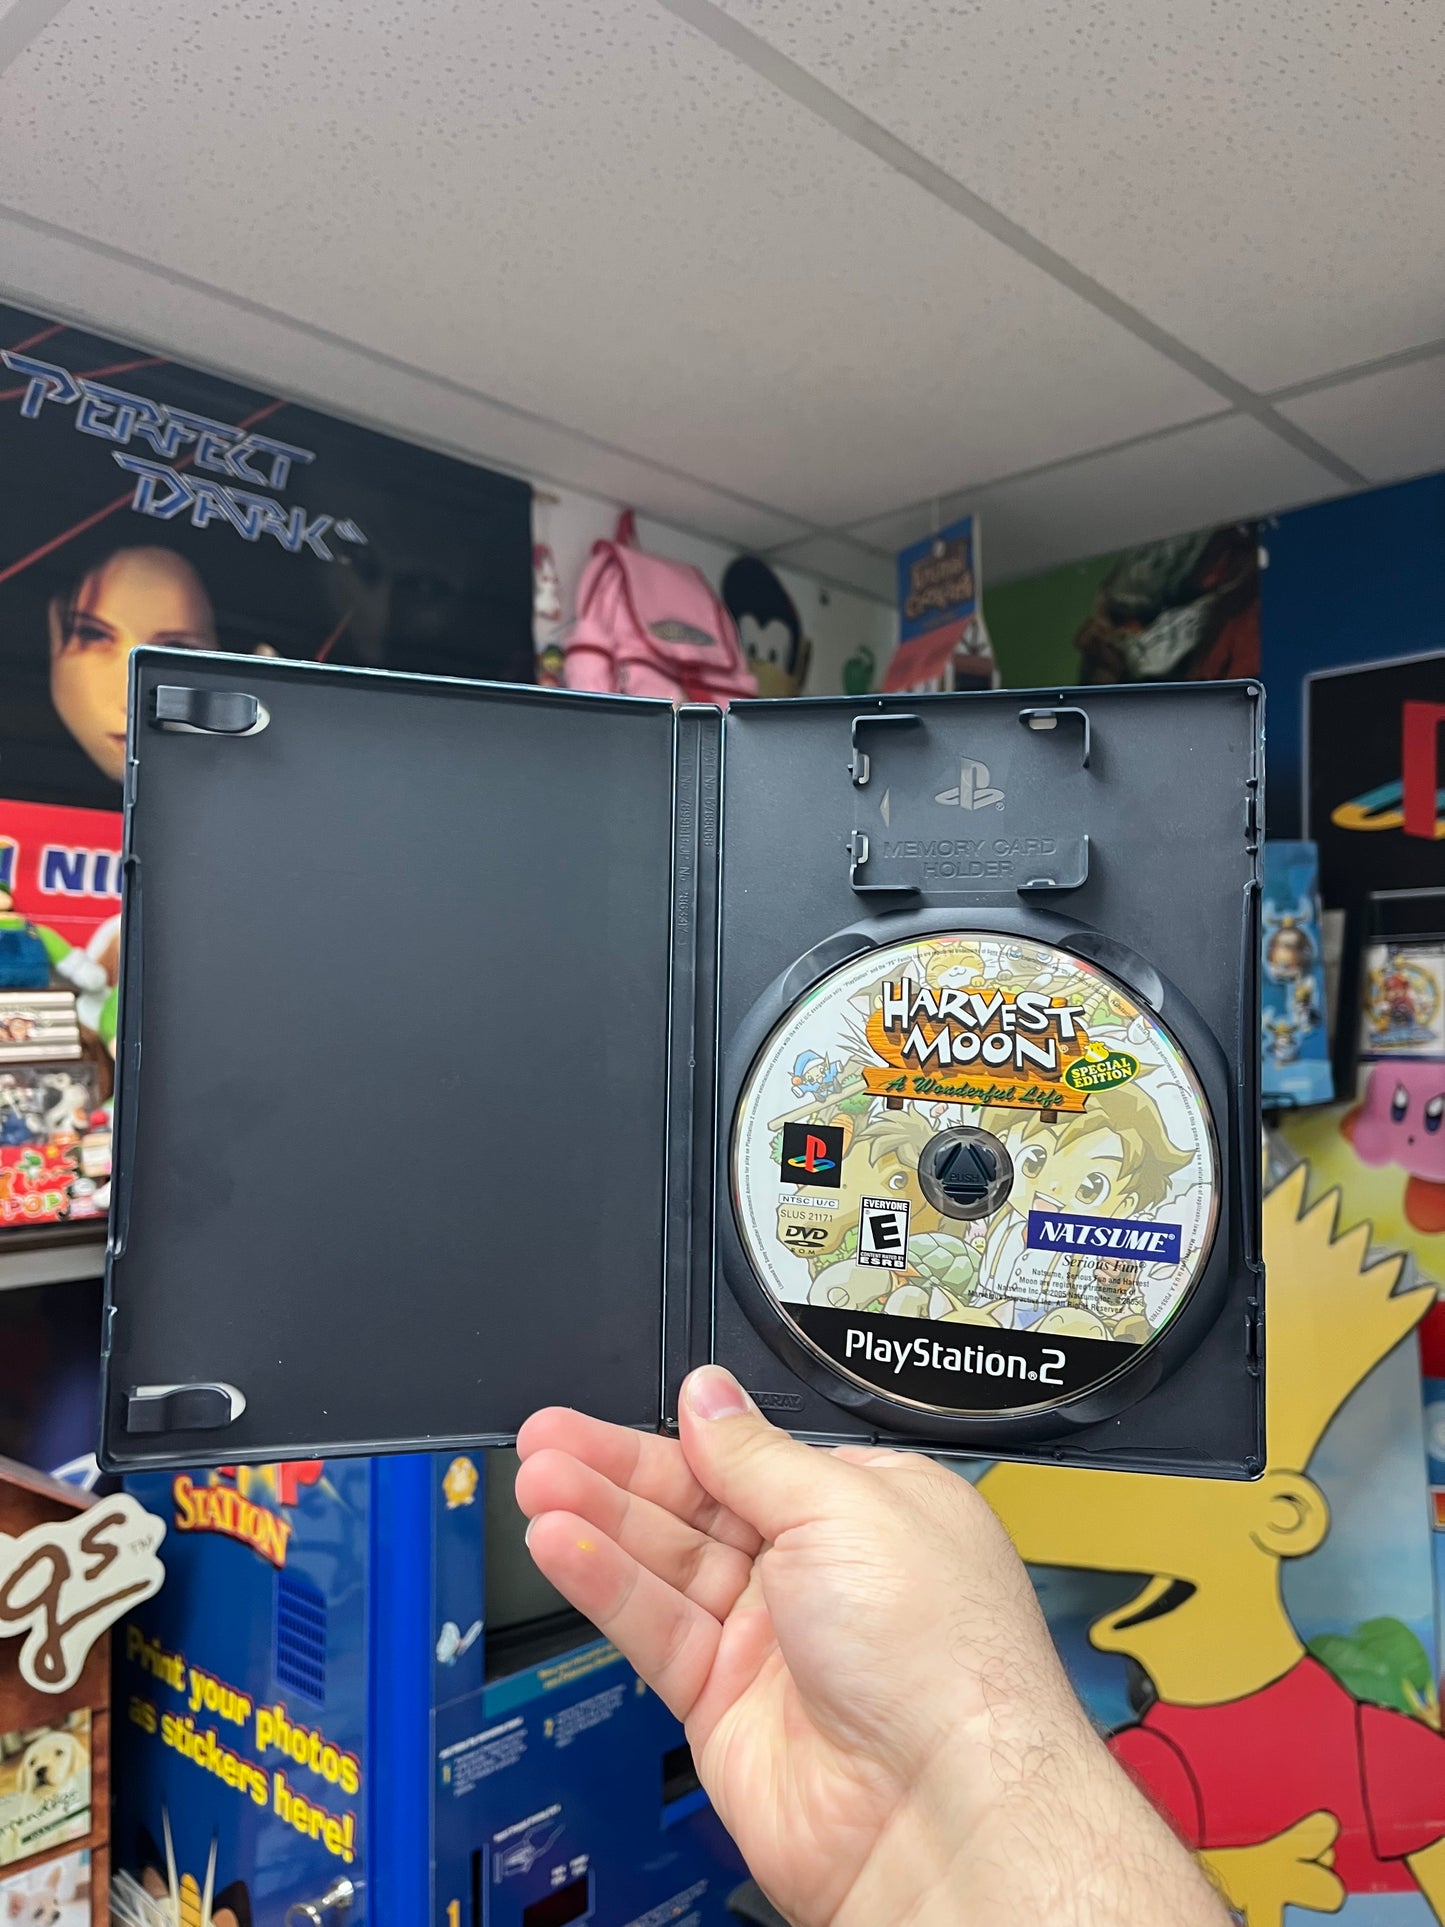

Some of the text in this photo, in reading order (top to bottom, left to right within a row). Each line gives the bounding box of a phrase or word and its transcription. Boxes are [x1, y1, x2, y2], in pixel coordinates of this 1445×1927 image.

[0, 350, 316, 490] PERFECT
[112, 451, 335, 562] DARK
[883, 838, 1057, 859] MEMORY CARD
[44, 849, 120, 893] NI
[923, 861, 1017, 879] HOLDER
[868, 965, 878, 974] and
[877, 962, 886, 970] the
[808, 992, 834, 1015] designation
[882, 977, 1085, 1041] HARVEST
[781, 1035, 791, 1046] with
[787, 1028, 796, 1037] the
[770, 1044, 786, 1064] systems
[1070, 1058, 1130, 1080] SPECIAL
[1156, 1049, 1178, 1080] performance
[756, 1061, 774, 1094] entertainment
[1073, 1067, 1133, 1089] EDITION
[885, 1075, 1065, 1107] A Wonderful Life
[749, 1092, 762, 1116] computer
[1188, 1115, 1196, 1126] this
[744, 1119, 755, 1147] PlayStation
[1190, 1126, 1199, 1141] game
[745, 1194, 757, 1228] Entertainment
[782, 1196, 836, 1207] NTSC U/C
[863, 1199, 908, 1212] EVERYONE
[1192, 1195, 1202, 1222] applicable
[780, 1209, 834, 1223] SLUS 21171
[752, 1227, 766, 1251] Computer
[785, 1225, 829, 1240] DVD
[869, 1213, 902, 1250] E
[760, 1250, 771, 1263] Sony
[765, 1262, 774, 1270] by
[860, 1252, 881, 1260] CONTENT
[881, 1253, 898, 1261] RATED
[860, 1258, 904, 1268] ESRB
[1062, 1254, 1109, 1271] Serious
[768, 1268, 784, 1290] Licensed
[1019, 1276, 1038, 1285] Moon
[1039, 1279, 1050, 1287] are
[1052, 1280, 1088, 1291] registered
[1089, 1284, 1127, 1295] trademarks
[1032, 1268, 1150, 1288] Natsume, Serious Fun and Harvest
[997, 1283, 1027, 1293] Natsume
[1068, 1291, 1098, 1301] Natsume
[1067, 1300, 1089, 1310] Rights
[174, 1475, 292, 1568] STATION
[126, 1625, 186, 1692] Print
[188, 1666, 252, 1727] your
[255, 1701, 361, 1795] photos
[128, 1695, 356, 1864] as stickers here!
